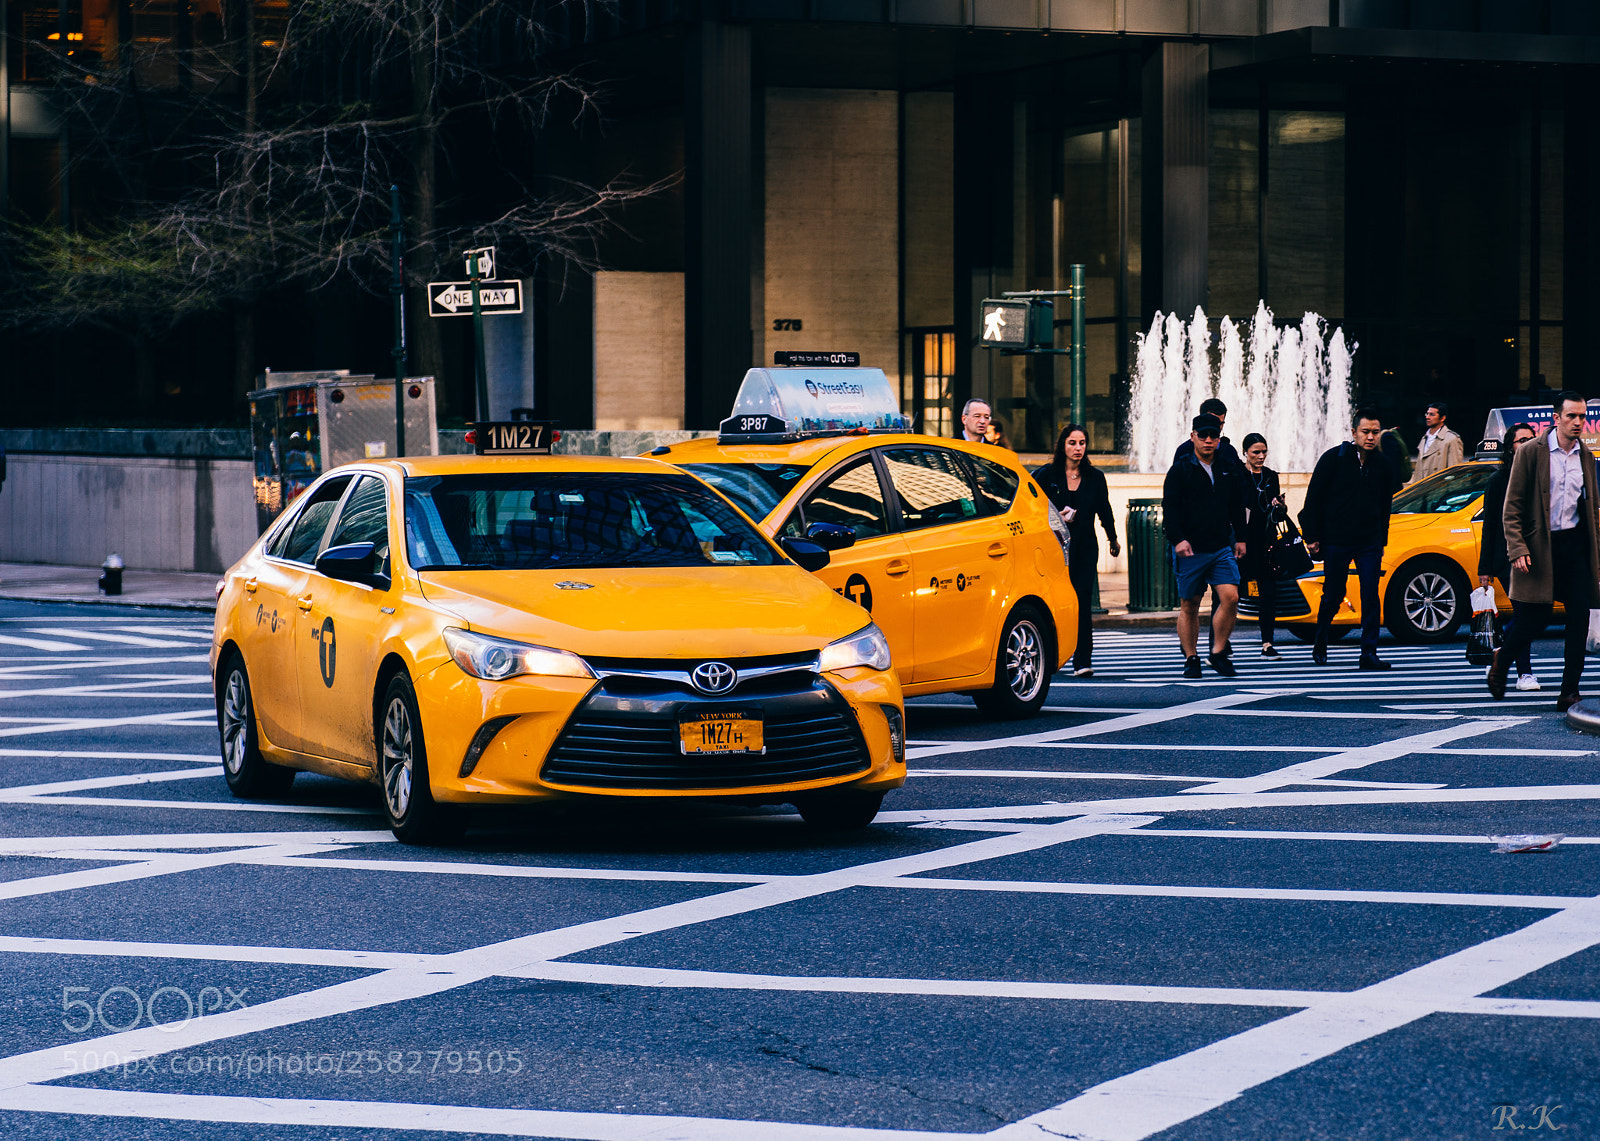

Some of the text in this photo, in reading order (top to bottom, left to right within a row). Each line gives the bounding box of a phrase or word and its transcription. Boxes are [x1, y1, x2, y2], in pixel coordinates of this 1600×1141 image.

[444, 291, 508, 305] ONE WAY
[830, 353, 847, 364] curb
[817, 382, 865, 397] StreetEasy
[740, 417, 768, 431] 3P87
[488, 425, 544, 449] 1M27
